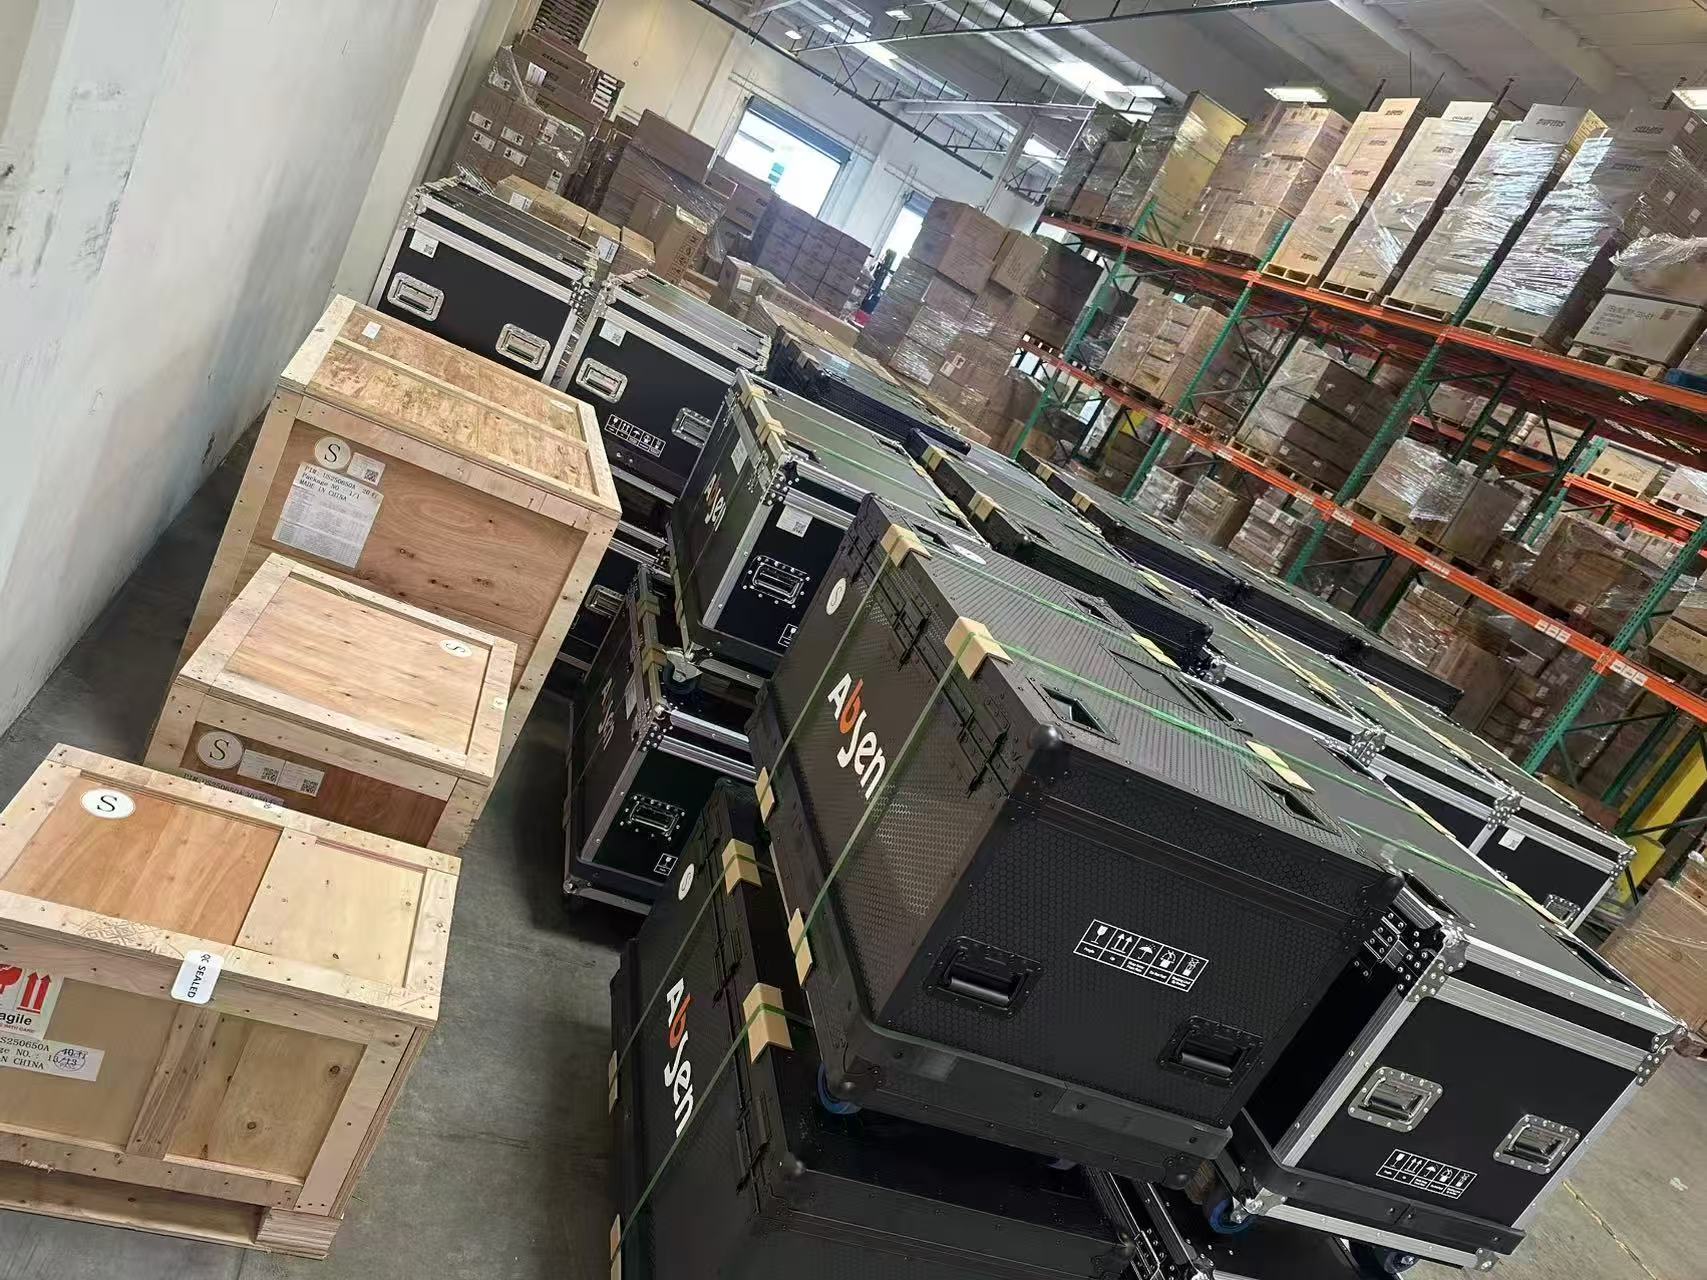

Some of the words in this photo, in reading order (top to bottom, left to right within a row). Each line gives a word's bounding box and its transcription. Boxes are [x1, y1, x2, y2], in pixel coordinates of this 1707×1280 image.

[323, 443, 341, 463] S
[209, 738, 229, 761] S
[96, 795, 118, 813] S
[187, 965, 207, 998] SEALED
[13, 1057, 44, 1070] CHINA
